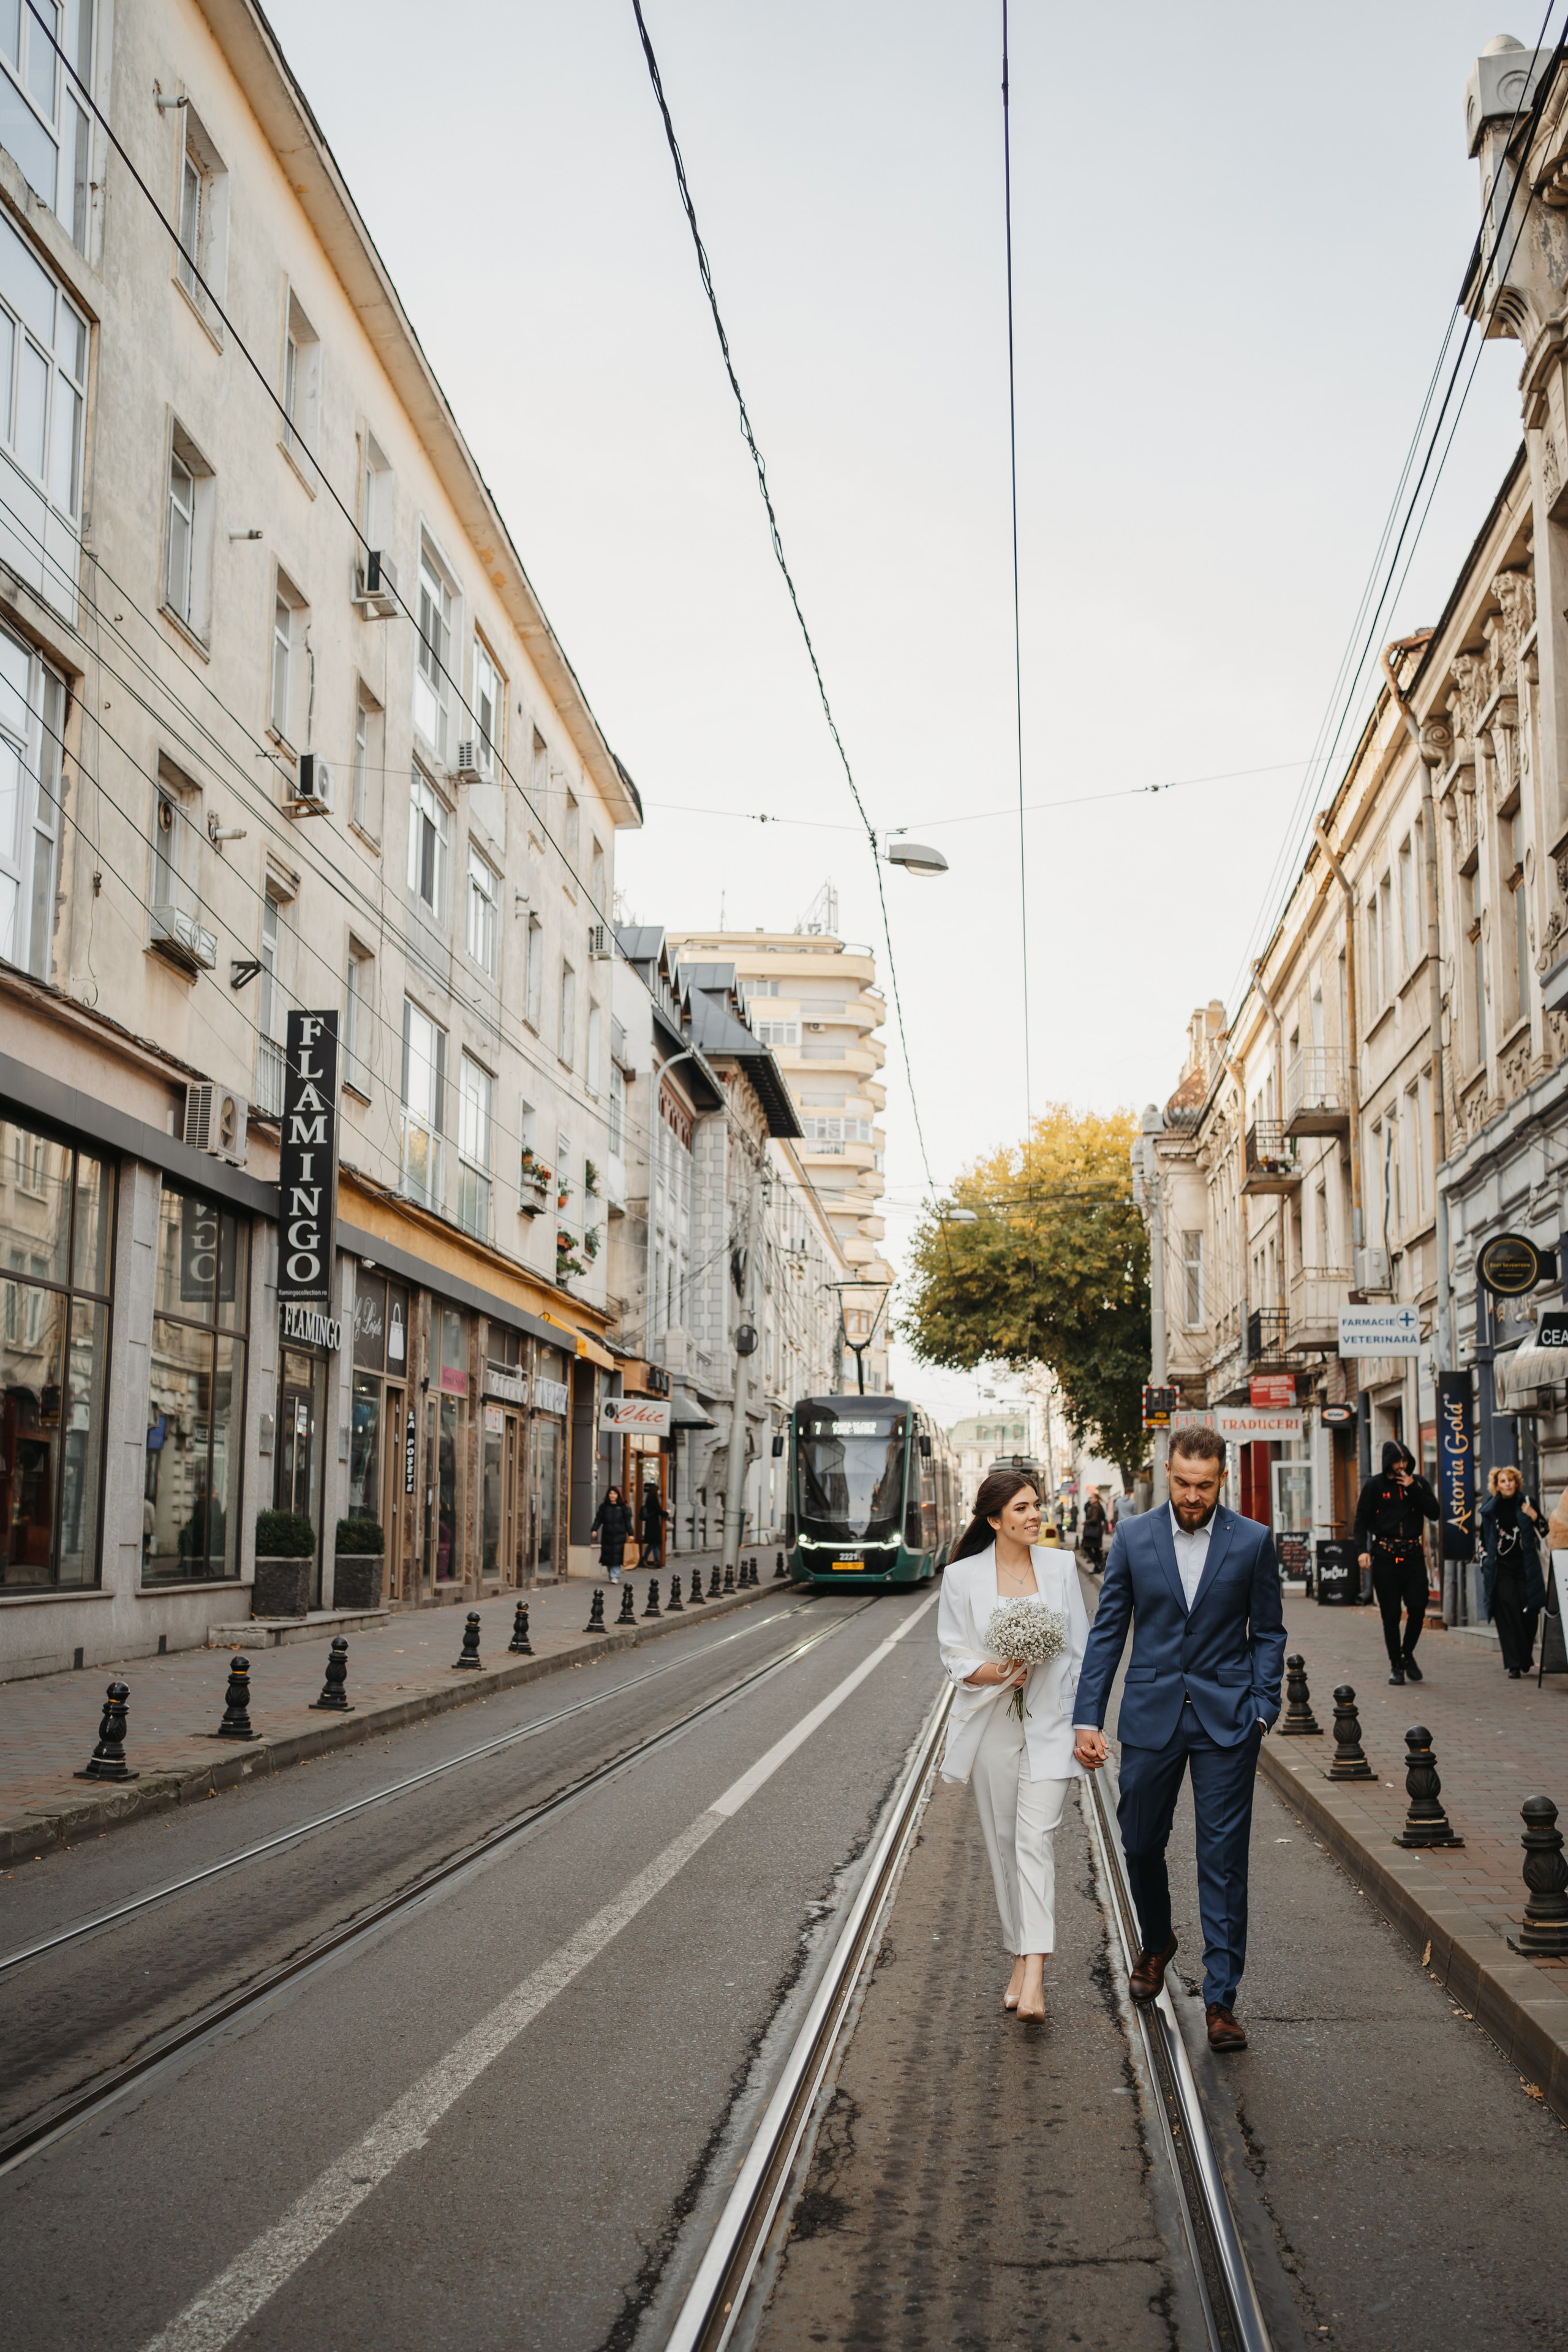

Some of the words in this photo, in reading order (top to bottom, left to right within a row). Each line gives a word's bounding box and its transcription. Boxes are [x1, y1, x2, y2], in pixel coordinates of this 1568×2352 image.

[286, 1016, 328, 1283] FLAMINGO
[278, 1289, 328, 1298] flamingocollection.ro
[284, 1303, 342, 1351] FLAMINGO
[1342, 1318, 1396, 1327] FARMACIE
[407, 1411, 415, 1429] LA
[614, 1404, 666, 1425] Chic
[815, 1421, 823, 1435] 7
[1221, 1419, 1299, 1430] TRADUCERI
[406, 1438, 415, 1492] POSETE
[1446, 1458, 1472, 1534] Astoria
[839, 1552, 858, 1561] 2221
